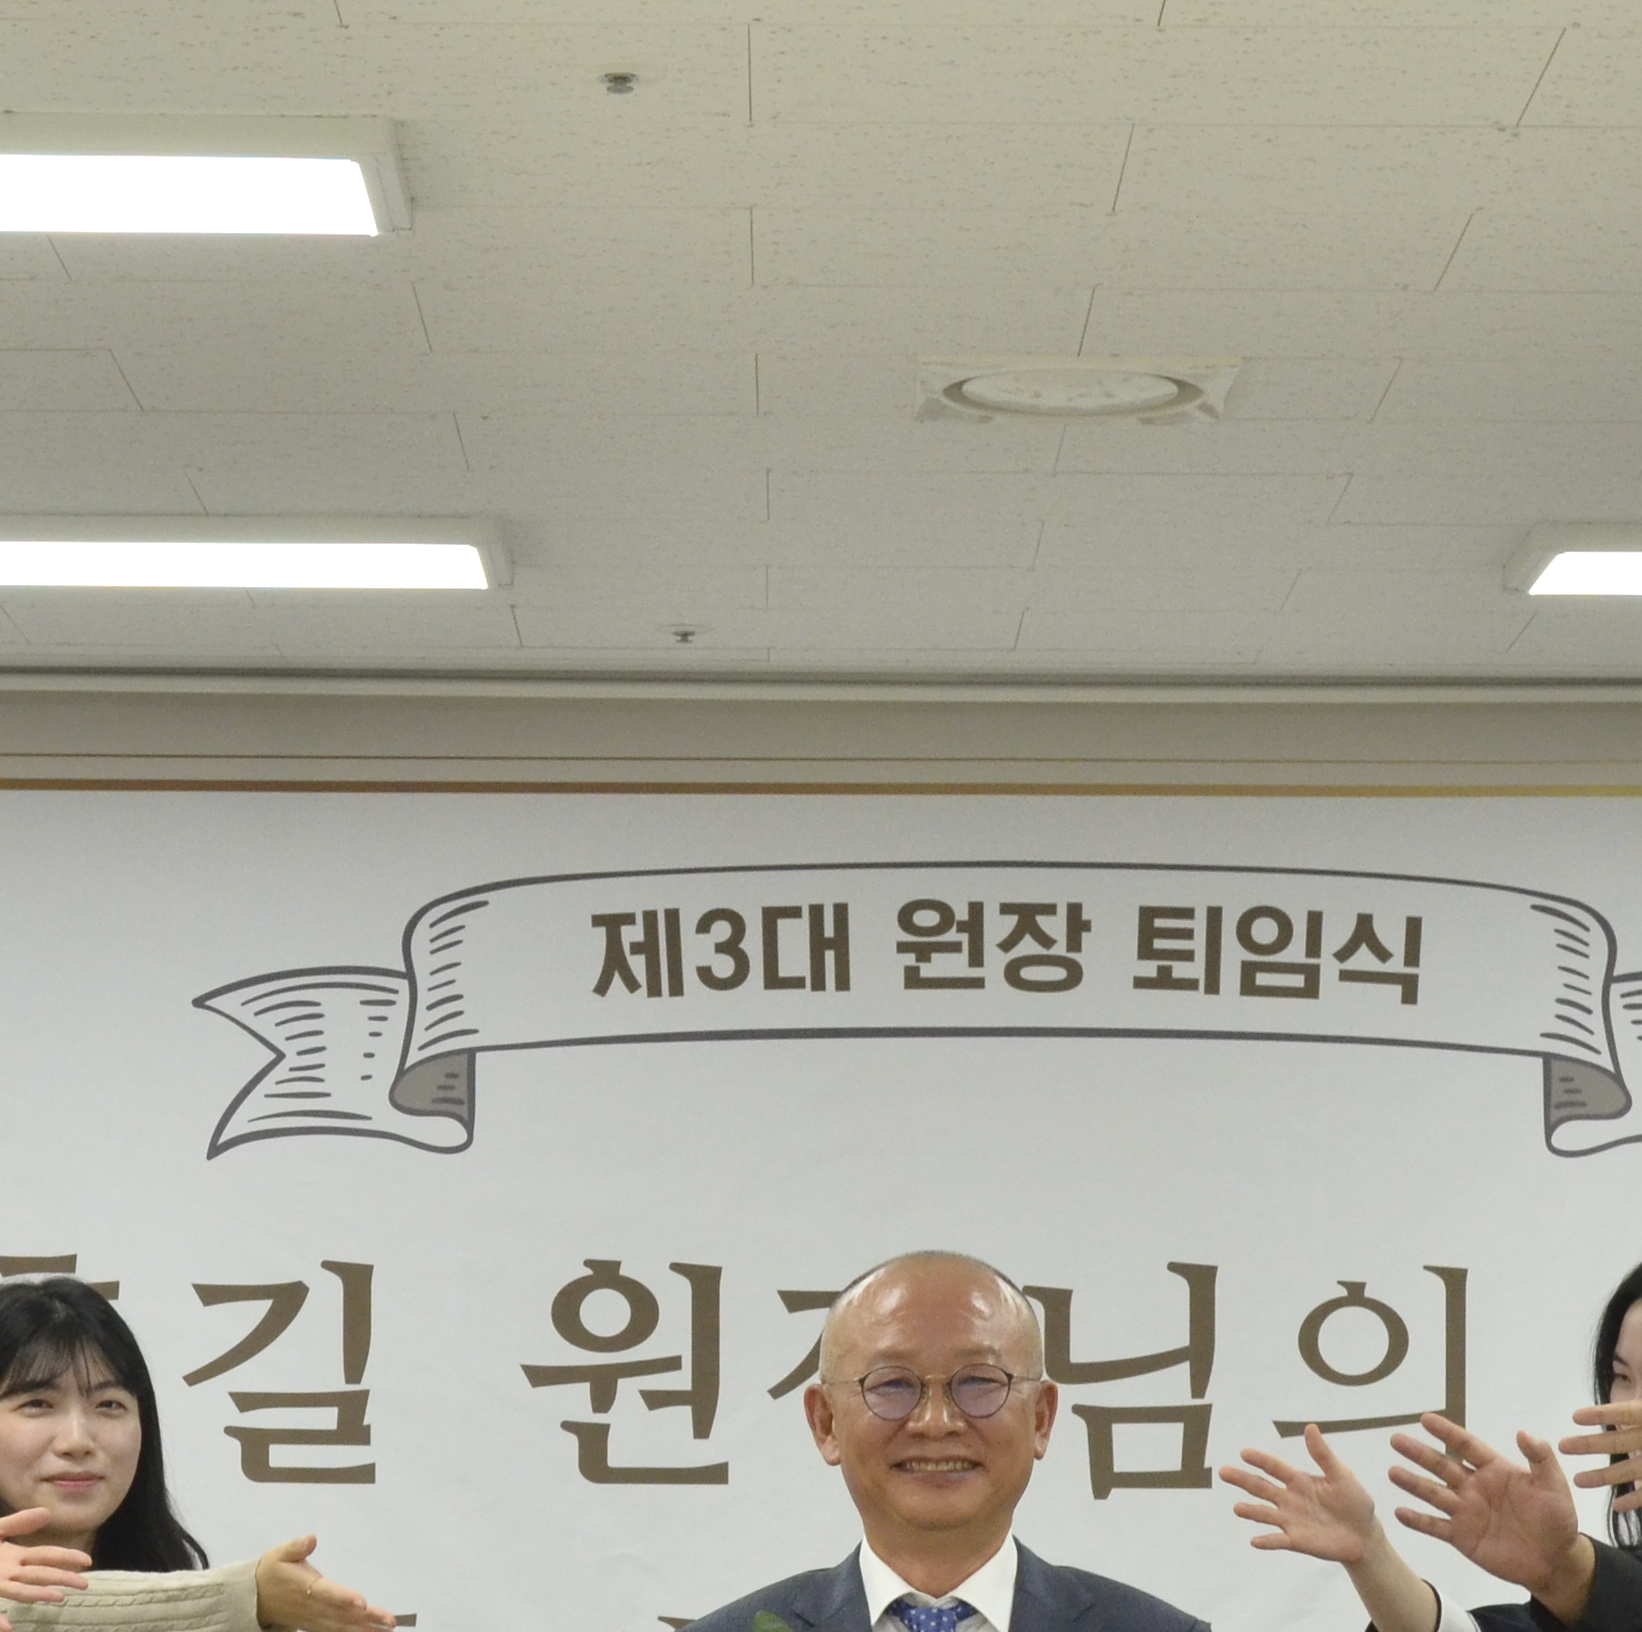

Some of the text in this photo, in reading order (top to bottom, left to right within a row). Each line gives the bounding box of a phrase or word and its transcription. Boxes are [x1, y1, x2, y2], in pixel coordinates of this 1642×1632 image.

[589, 896, 1424, 1006] 제3대 원장 퇴임식
[519, 1257, 1469, 1501] 원님의
